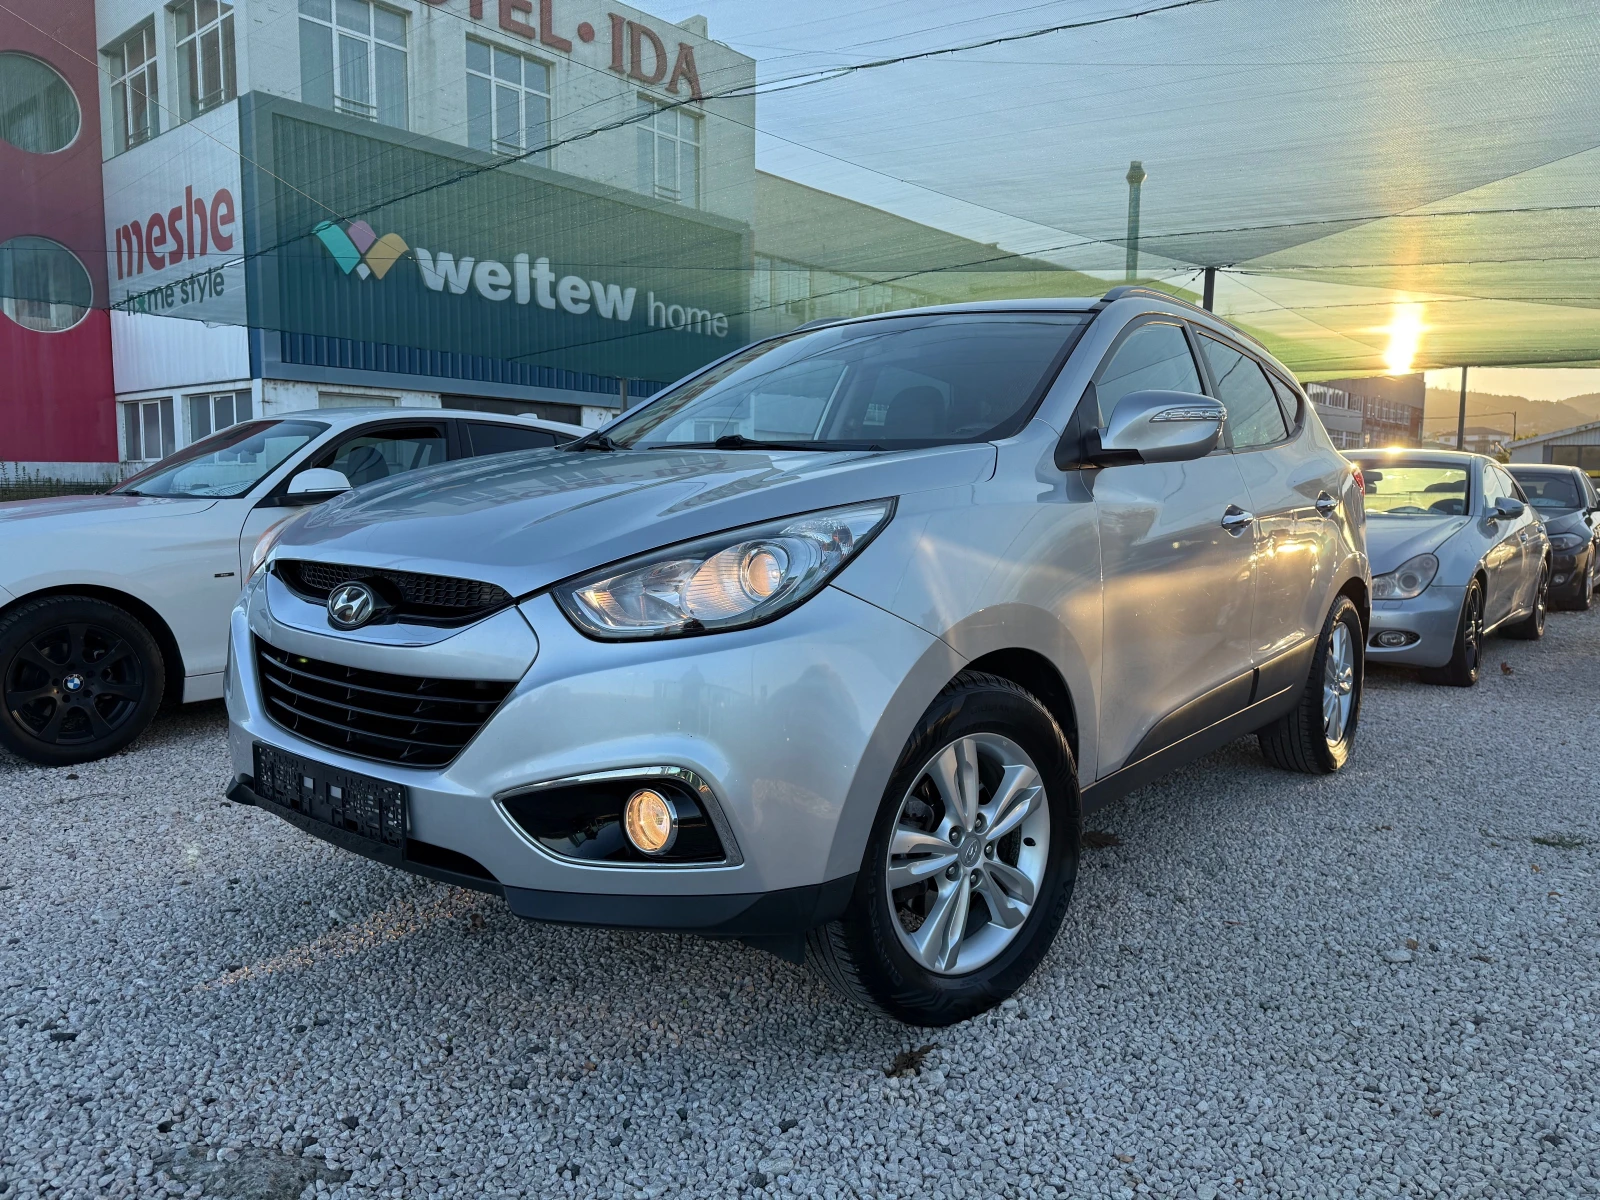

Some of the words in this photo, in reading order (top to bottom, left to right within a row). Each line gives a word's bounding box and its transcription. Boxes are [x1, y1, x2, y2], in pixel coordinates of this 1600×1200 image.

[423, 0, 572, 53] EL
[608, 12, 703, 103] IDA
[115, 184, 235, 281] meshe
[180, 267, 225, 303] style
[413, 246, 637, 321] weltew
[647, 290, 729, 338] home
